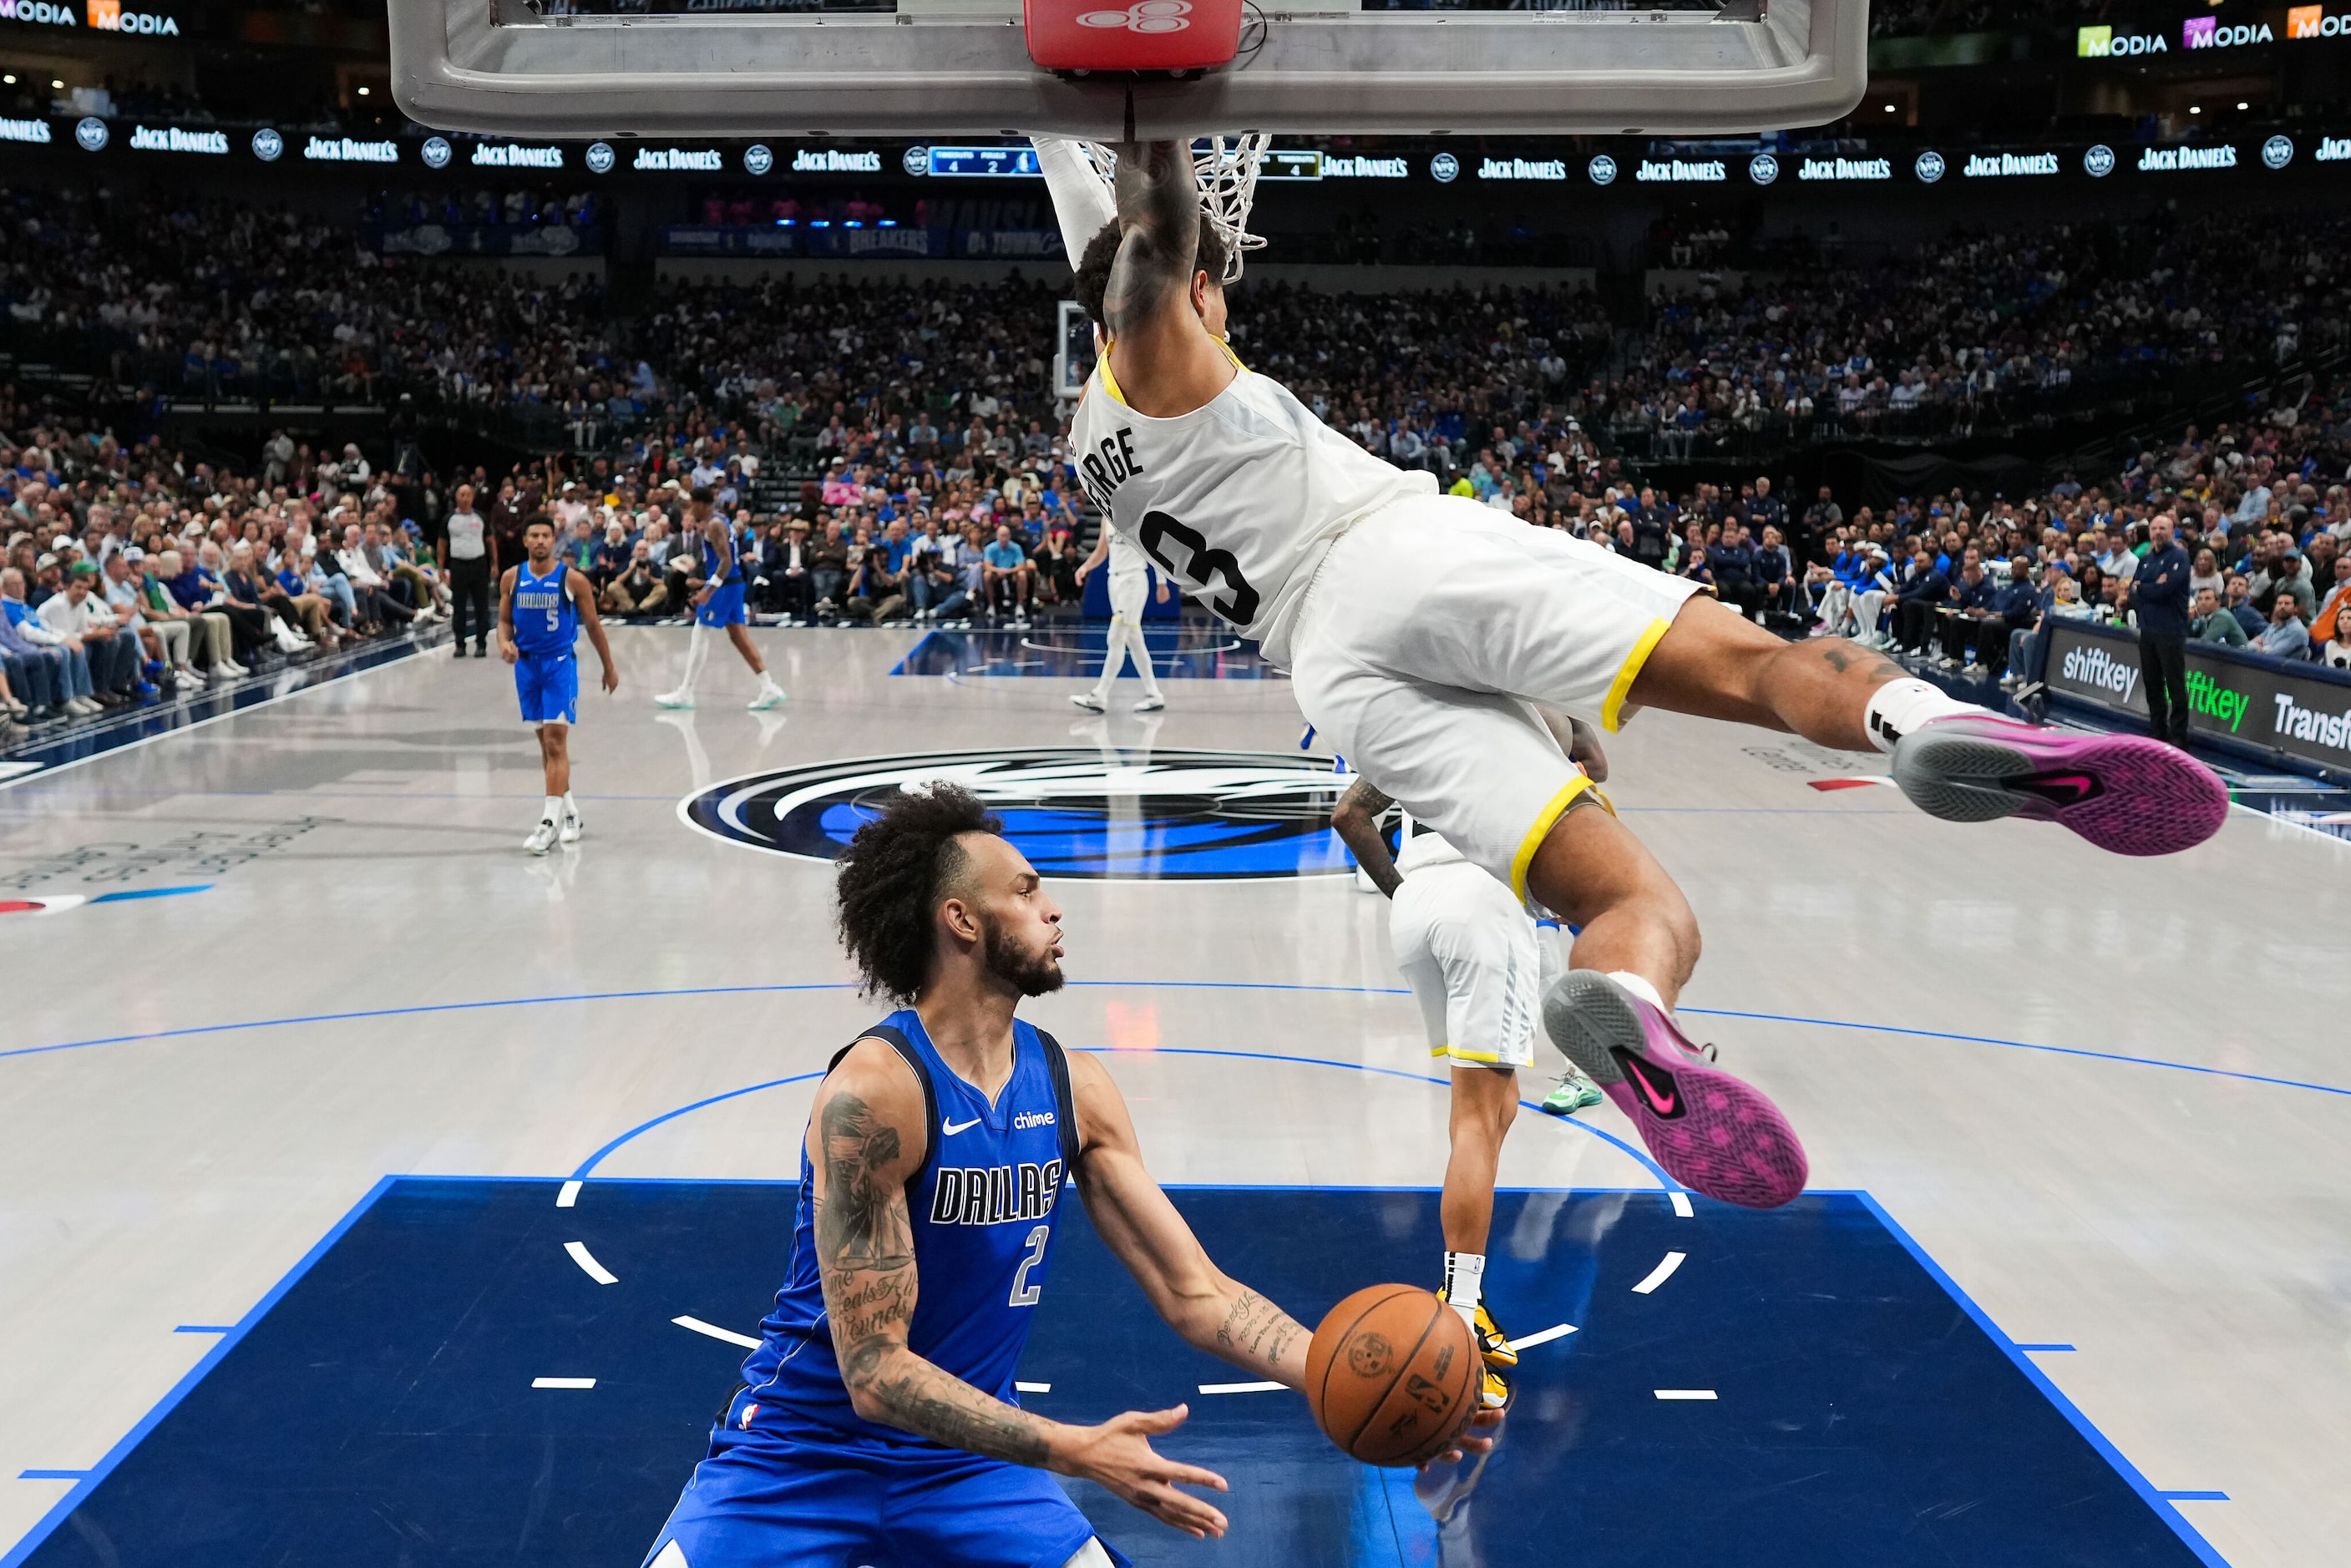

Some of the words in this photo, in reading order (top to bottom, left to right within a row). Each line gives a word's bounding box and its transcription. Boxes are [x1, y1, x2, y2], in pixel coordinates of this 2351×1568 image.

[97, 11, 180, 37] MODIA
[2087, 34, 2167, 57] MODIA
[2191, 23, 2273, 49] MODIA
[0, 115, 51, 143] ANIEL'S
[130, 125, 169, 149] JACK
[304, 136, 341, 159] JACK
[472, 144, 507, 165] JACK
[634, 148, 668, 169] JACK
[2138, 148, 2176, 170] JACK
[2177, 144, 2237, 169] DANIEL'S
[793, 149, 827, 170] JACK
[948, 160, 959, 172] 4
[988, 161, 998, 173] 2
[1322, 156, 1354, 176] JACK
[1355, 156, 1408, 177] DANIEL'S
[1478, 158, 1512, 179] JACK
[1513, 158, 1566, 180] DANIEL'S
[1636, 160, 1671, 181] JACK
[1672, 160, 1725, 181] DANIEL'S
[1799, 159, 1834, 180] JACK
[1835, 158, 1891, 180] DANIEL'S
[1964, 154, 2000, 177] JACK
[2002, 153, 2058, 175] DANIEL'S
[1139, 510, 1260, 626] 3
[546, 609, 559, 632] 5
[2063, 646, 2139, 704] shiftkey
[1013, 1110, 1056, 1130] chime
[930, 1157, 1061, 1226] DALLAS
[1008, 1225, 1050, 1308] 2
